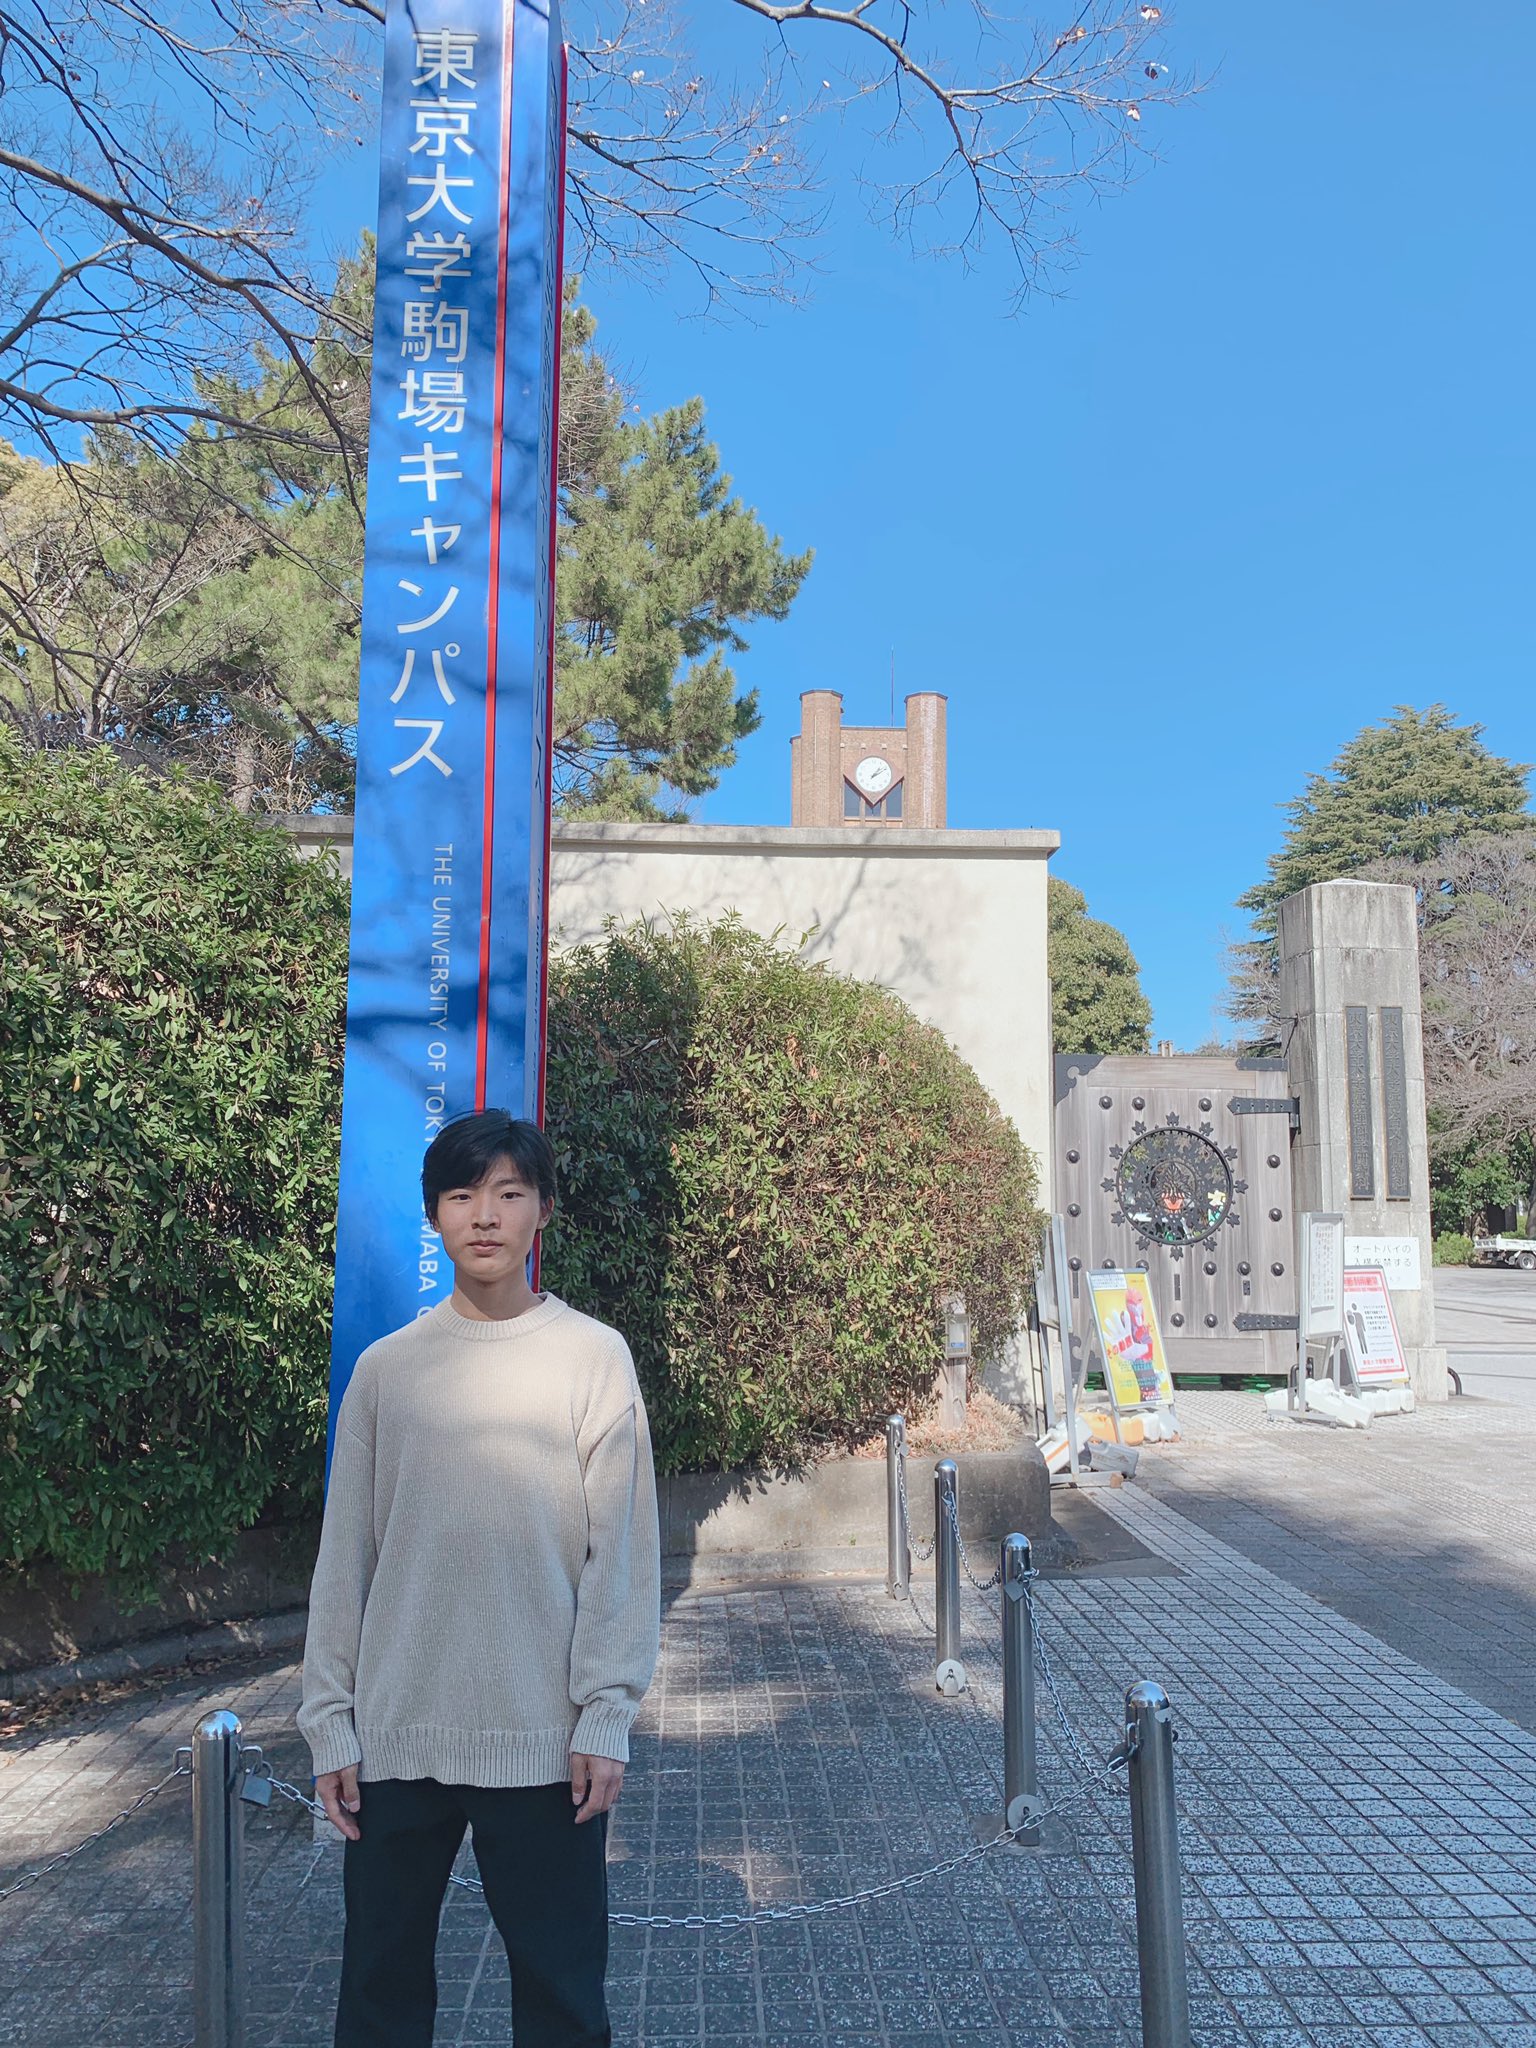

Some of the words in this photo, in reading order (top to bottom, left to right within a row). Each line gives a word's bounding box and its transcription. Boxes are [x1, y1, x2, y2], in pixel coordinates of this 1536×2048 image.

[389, 27, 479, 778] 東京大学駒場キャンパス
[432, 843, 454, 886] THE
[427, 897, 452, 1033] UNIVERSITY
[426, 1041, 446, 1073] OF
